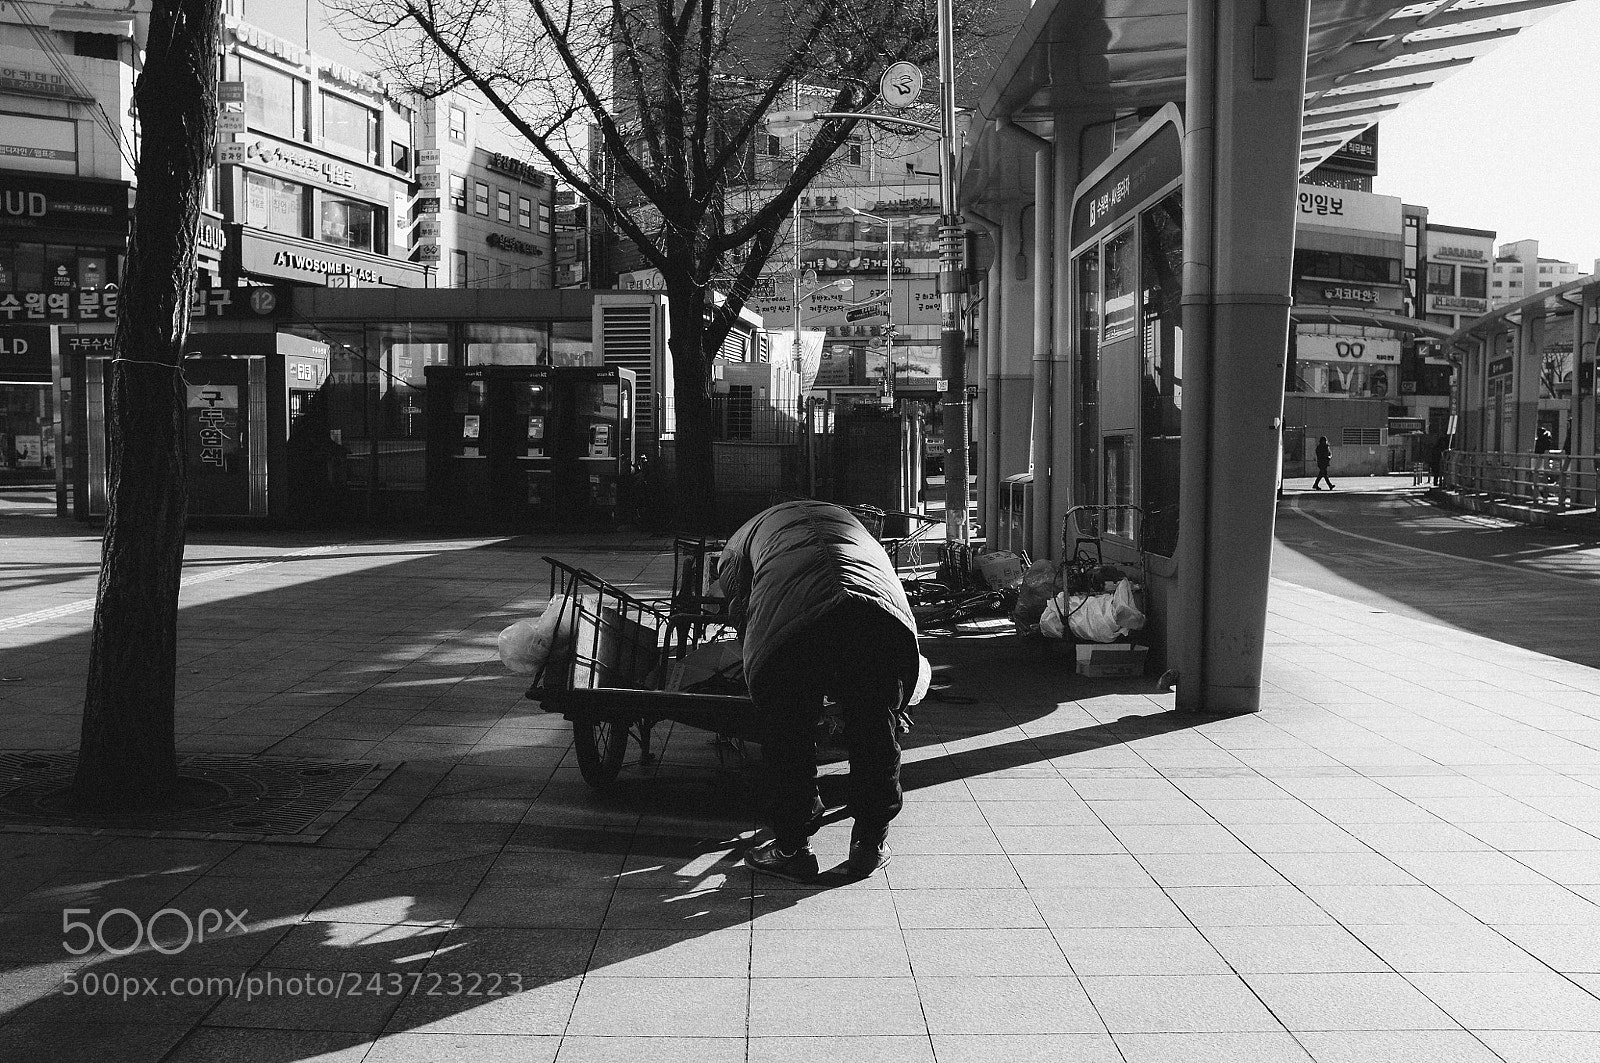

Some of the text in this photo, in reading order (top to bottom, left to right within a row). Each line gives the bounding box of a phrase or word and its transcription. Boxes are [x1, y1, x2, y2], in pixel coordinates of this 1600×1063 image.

[3, 69, 62, 84] 아카데미
[0, 190, 47, 216] UD
[197, 225, 225, 250] LOUD
[286, 251, 341, 274] TWOSOME
[0, 292, 69, 319] 수원역
[69, 338, 114, 351] 구두수선
